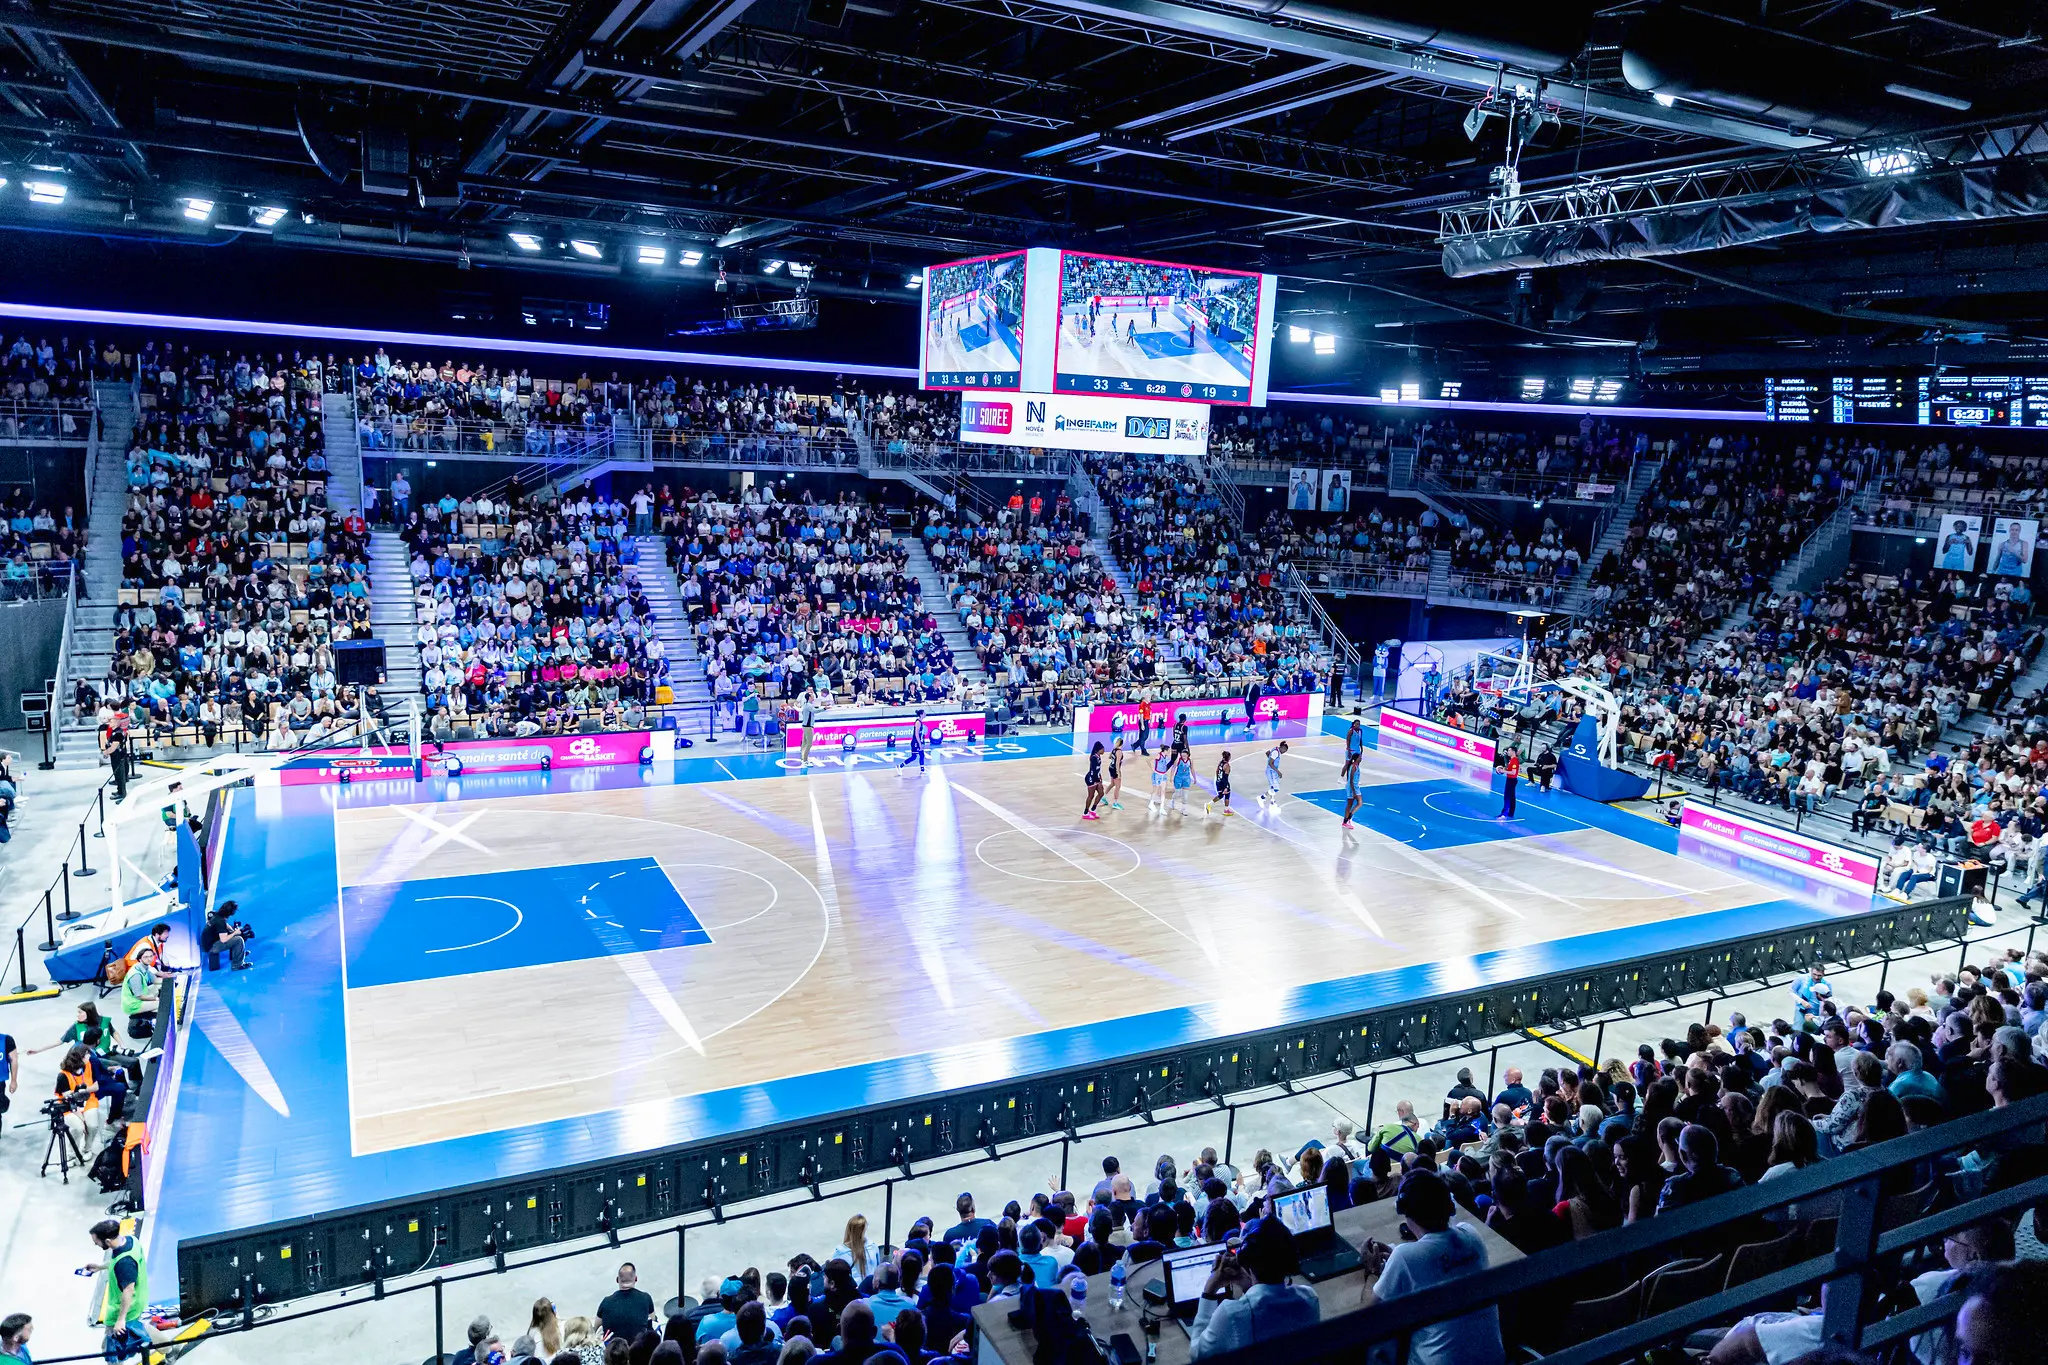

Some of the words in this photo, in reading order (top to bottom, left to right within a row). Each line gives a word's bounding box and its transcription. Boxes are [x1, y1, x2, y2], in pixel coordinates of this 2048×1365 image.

[942, 374, 949, 384] 33
[994, 374, 1002, 384] 19
[1093, 379, 1108, 390] 33
[1146, 384, 1166, 394] 6:28
[1202, 386, 1216, 398] 19
[980, 408, 1008, 426] SOIREE
[1953, 410, 1984, 420] 6:28
[1066, 418, 1117, 430] INGEFARM
[1517, 616, 1523, 624] 2
[1540, 616, 1545, 625] 2
[498, 750, 528, 761] santé
[531, 748, 545, 760] du
[584, 752, 616, 762] BASKET
[1702, 818, 1736, 836] Mutami
[1743, 834, 1778, 850] partenaire
